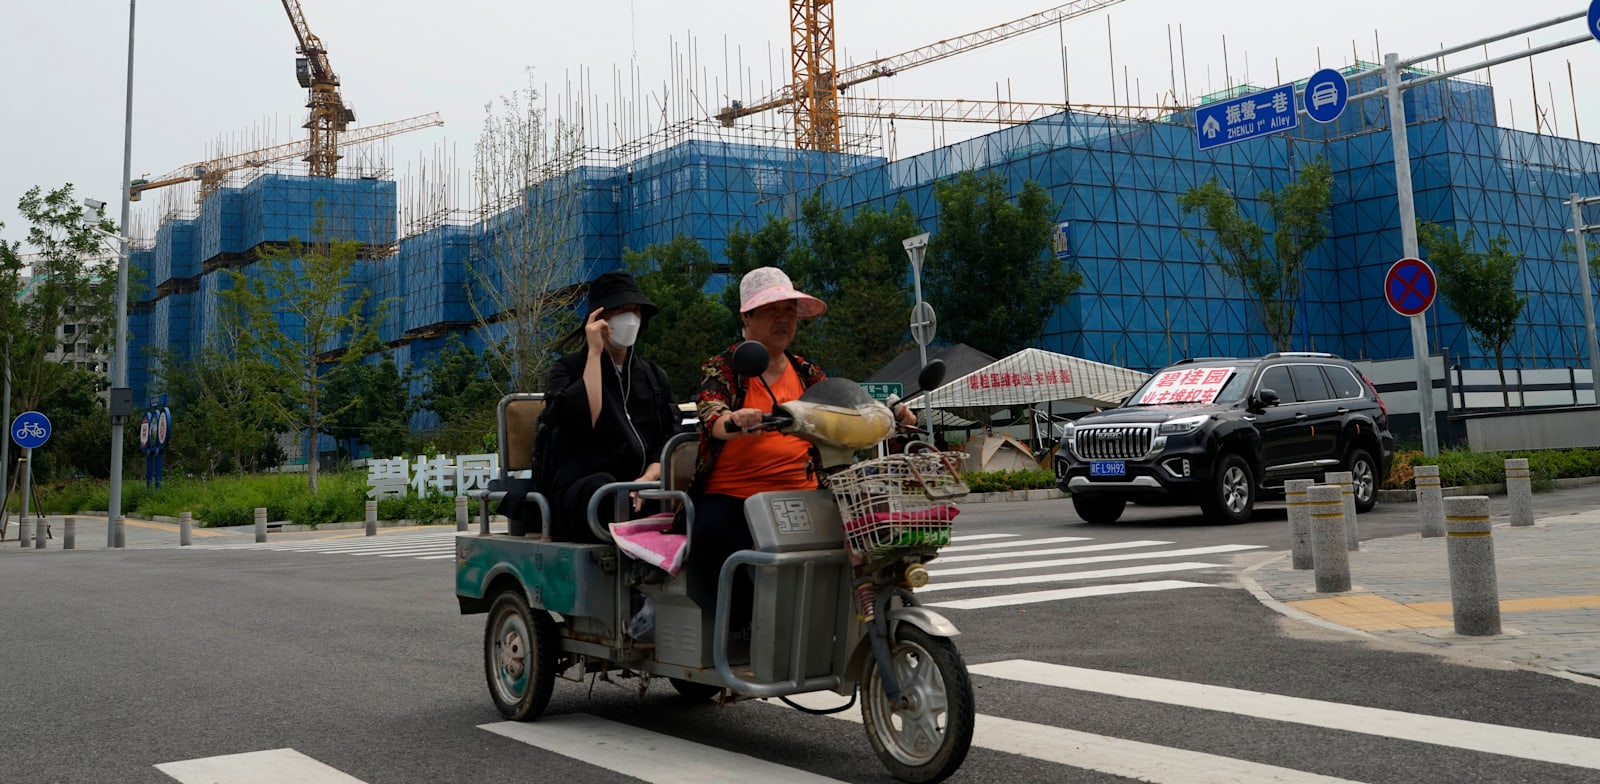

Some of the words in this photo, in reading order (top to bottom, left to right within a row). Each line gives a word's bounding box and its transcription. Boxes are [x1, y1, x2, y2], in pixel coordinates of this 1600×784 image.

[1225, 92, 1288, 125] 振鹭一巷
[1227, 123, 1254, 139] ZHENLU
[1270, 115, 1290, 128] Alley
[1156, 368, 1229, 388] 碧桂园
[1143, 388, 1217, 404] 业主维权车
[366, 453, 499, 501] 碧桂园
